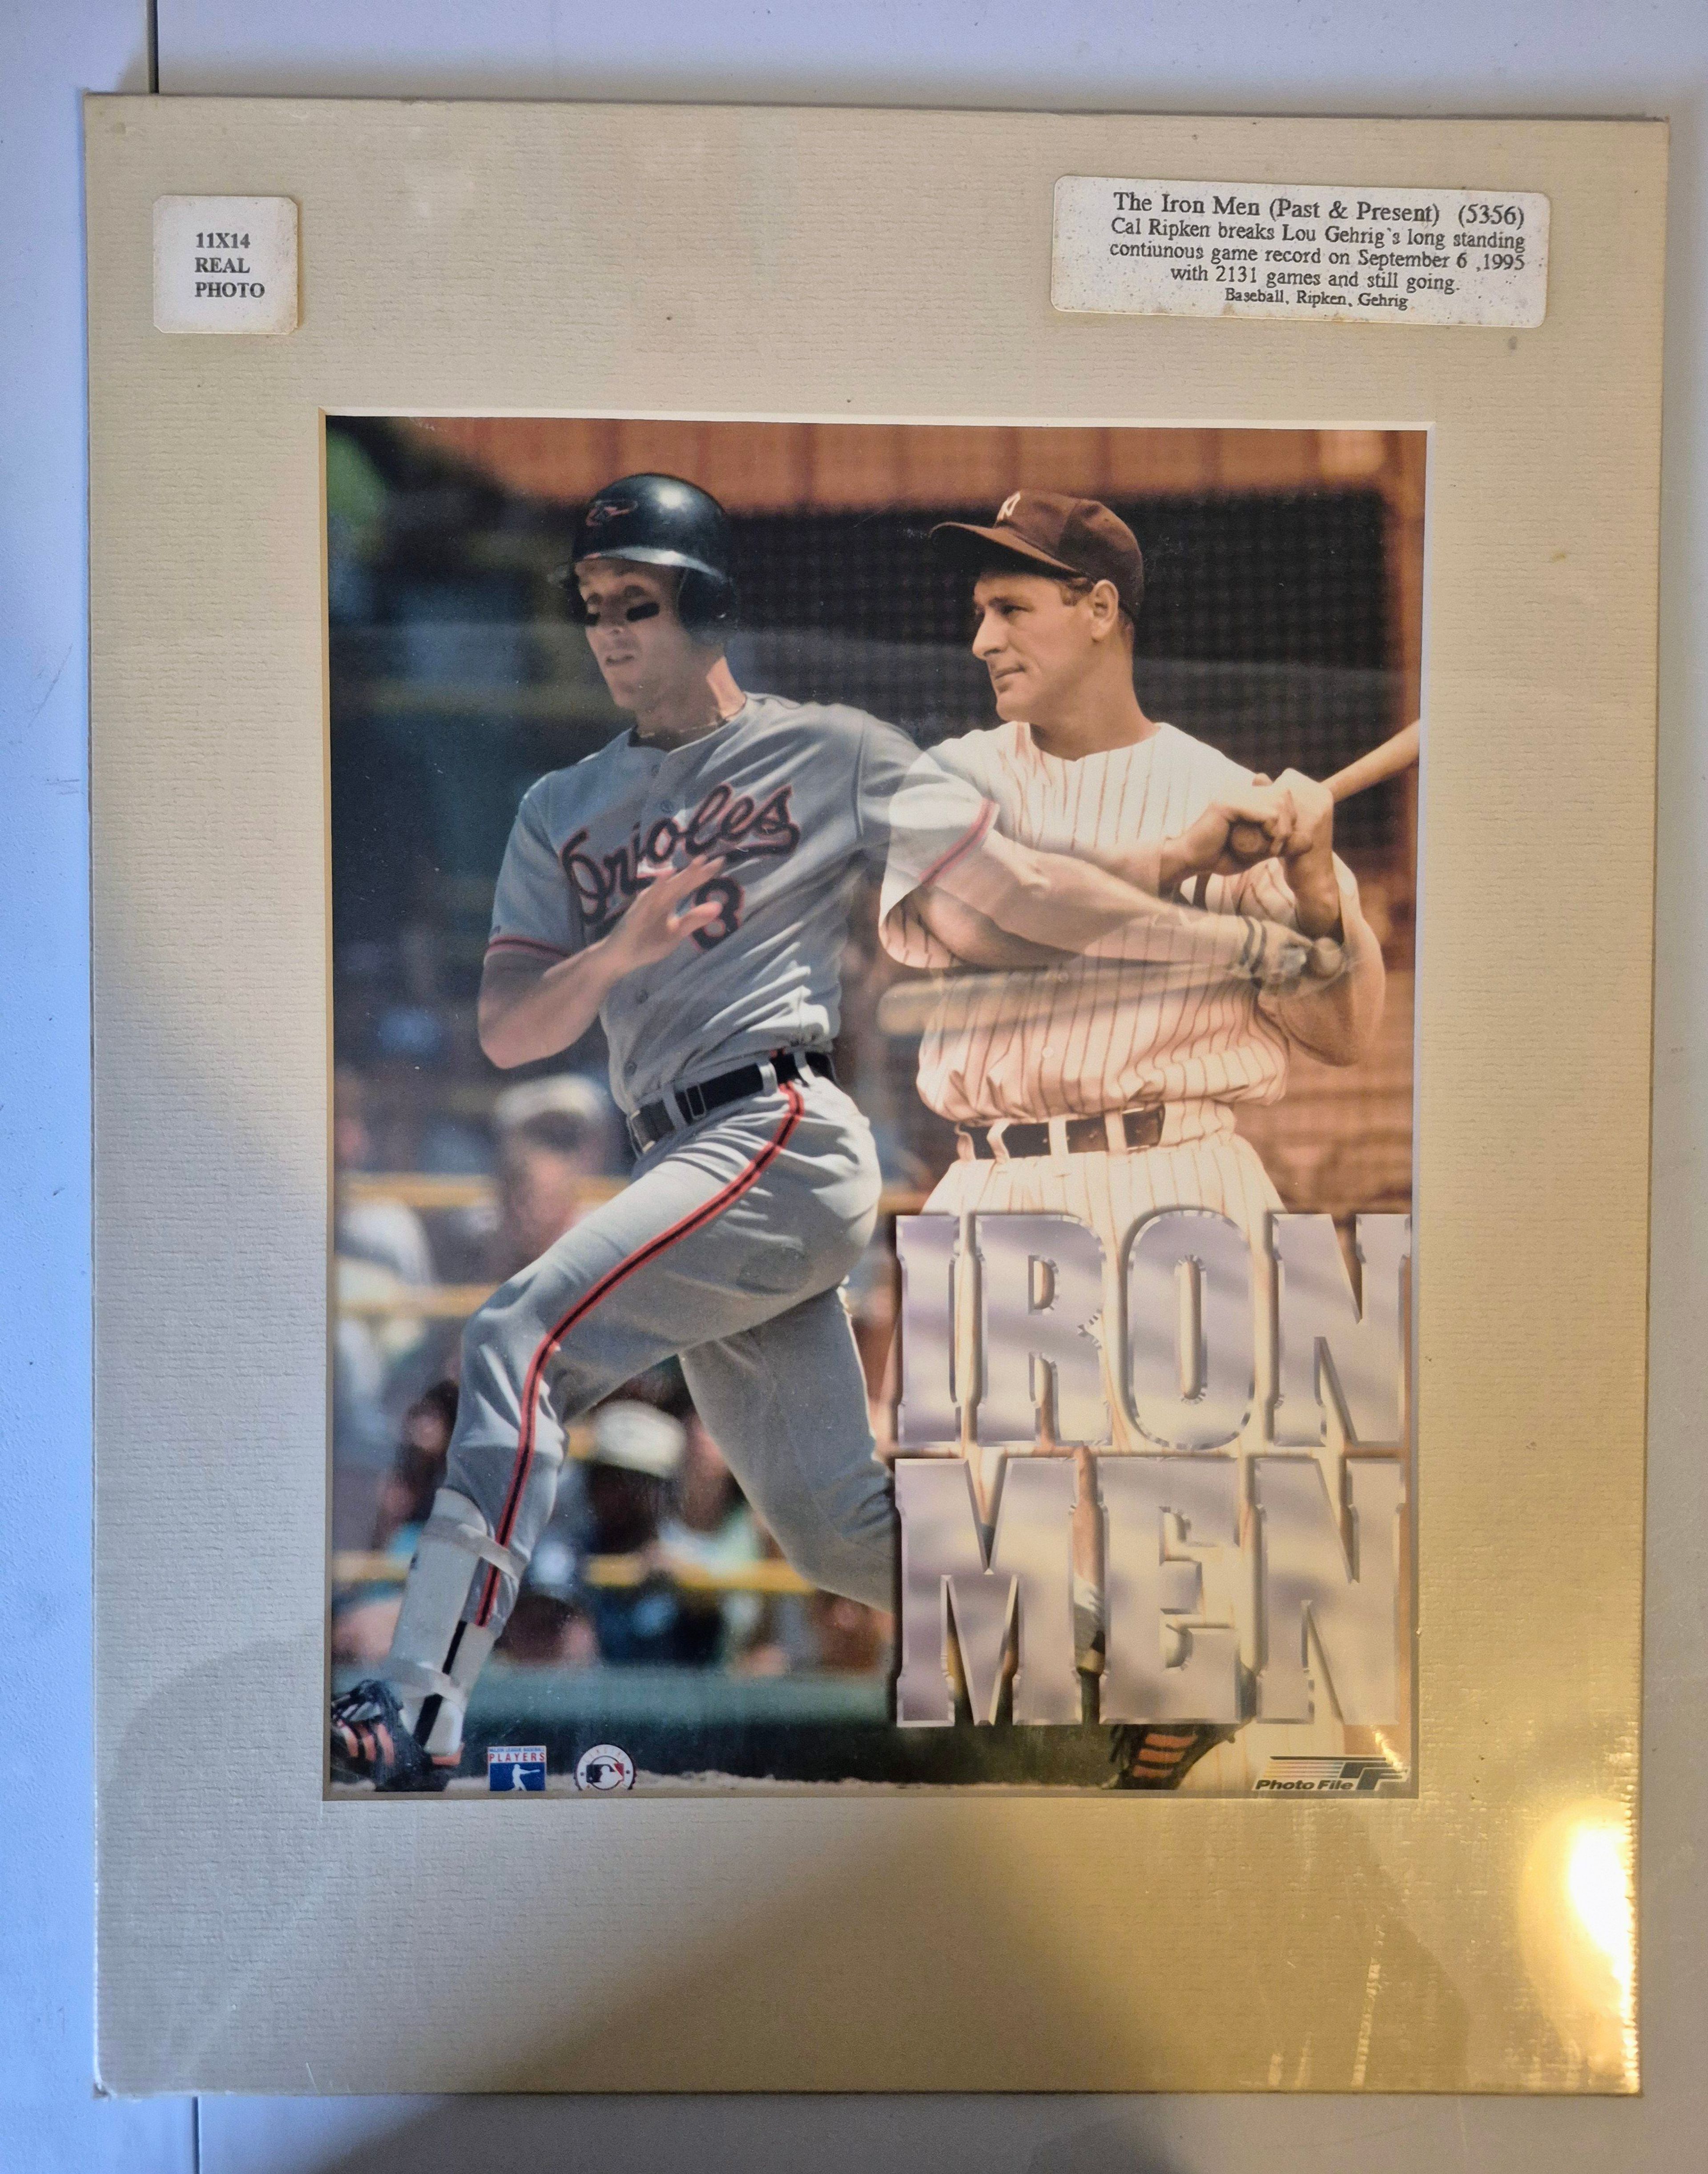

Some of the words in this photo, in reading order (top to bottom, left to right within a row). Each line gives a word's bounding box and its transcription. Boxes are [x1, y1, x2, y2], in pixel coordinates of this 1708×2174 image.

[1113, 192, 1152, 211] The
[1161, 193, 1205, 214] Iron
[1212, 196, 1260, 216] Men
[1269, 198, 1321, 222] (Past
[1329, 200, 1348, 219] &
[1356, 201, 1440, 228] Present)
[1458, 204, 1524, 230] (5356)
[196, 232, 250, 249] 11X14
[1112, 217, 1141, 235] Cal
[1148, 218, 1210, 240] Ripken
[1218, 221, 1275, 240] breaks
[1282, 224, 1316, 241] Lou
[1407, 229, 1446, 250] long
[1453, 232, 1525, 253] standing
[194, 257, 250, 273] REAL
[1109, 241, 1204, 259] contiunous
[1211, 248, 1258, 264] game
[1265, 248, 1323, 264] record
[1328, 252, 1349, 265] on
[1358, 249, 1450, 271] September
[1456, 252, 1467, 269] 6
[194, 282, 265, 298] PHOTO
[1171, 264, 1208, 282] with
[1215, 266, 1257, 283] 2131
[1266, 271, 1322, 288] games
[1328, 271, 1358, 286] and
[1367, 271, 1398, 288] still
[1406, 273, 1460, 295] going.
[1358, 293, 1409, 310] Gehrig
[895, 1208, 1412, 1450] IRON
[894, 1456, 1406, 1727] MEN
[489, 1753, 544, 1762] PLAYERS
[1255, 1779, 1315, 1790] Photo
[1316, 1780, 1354, 1790] File
